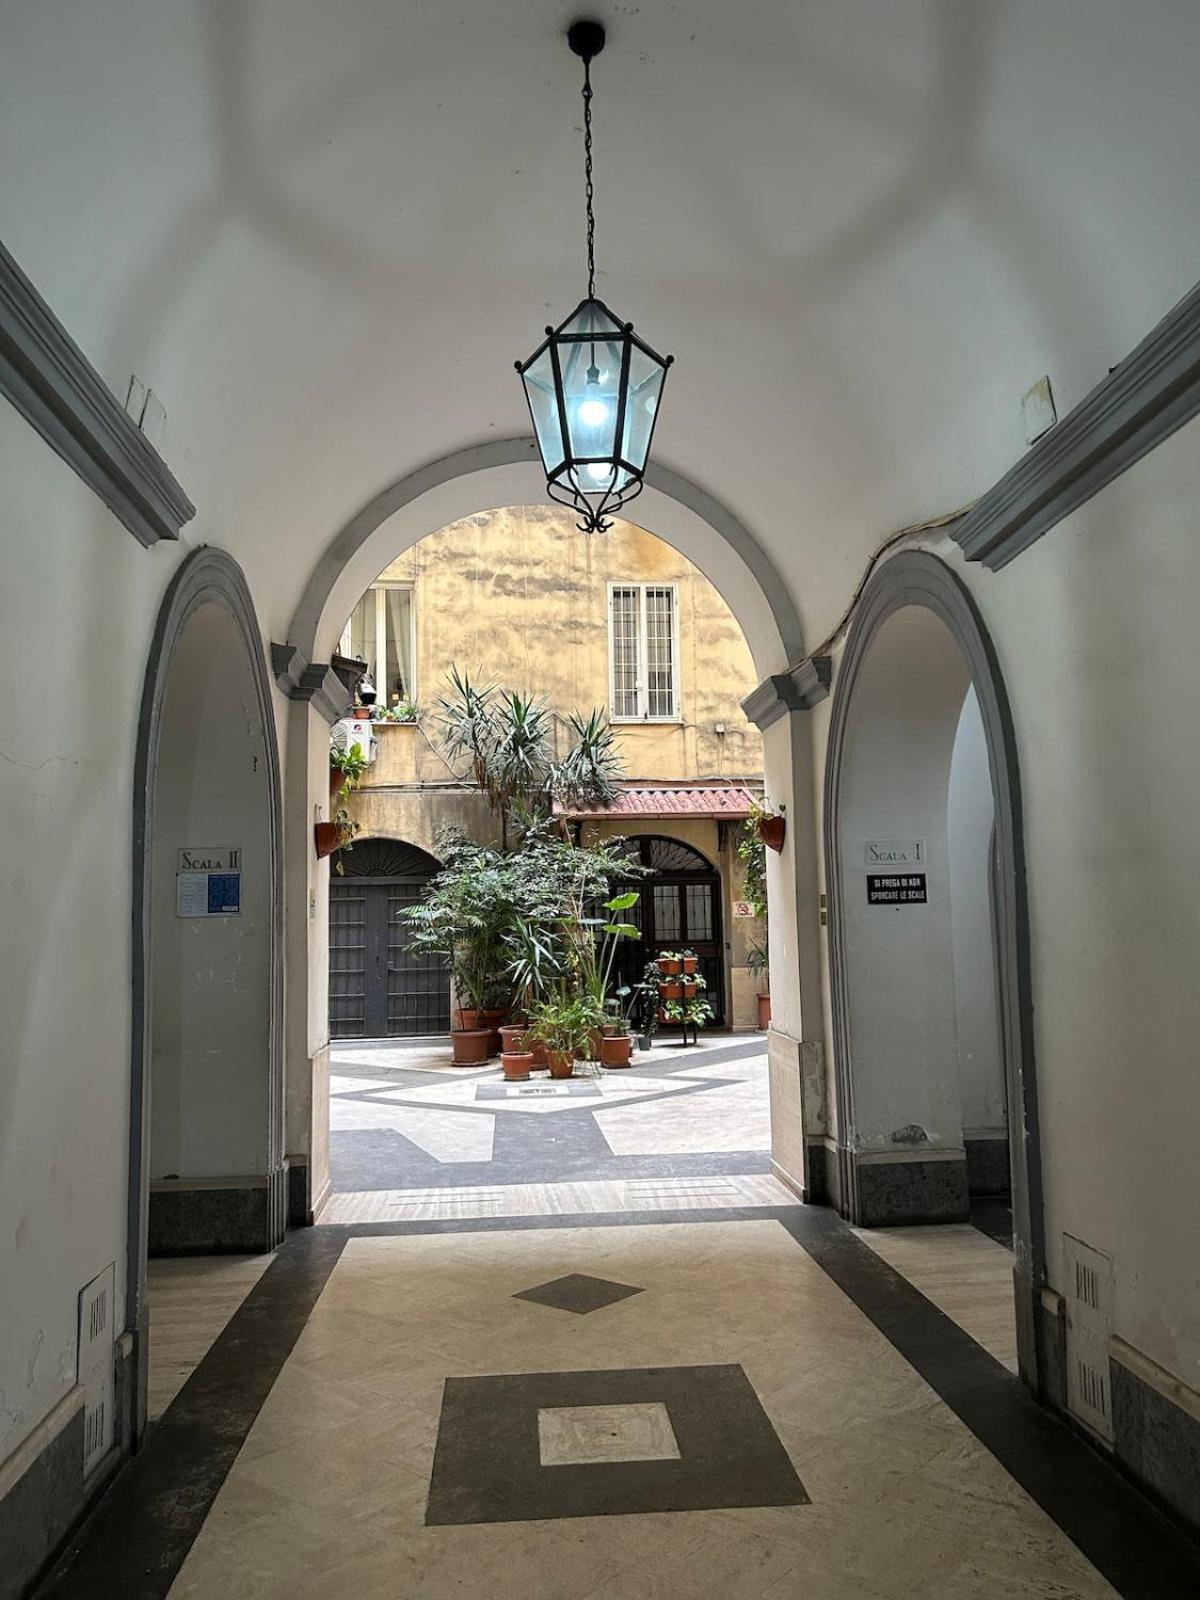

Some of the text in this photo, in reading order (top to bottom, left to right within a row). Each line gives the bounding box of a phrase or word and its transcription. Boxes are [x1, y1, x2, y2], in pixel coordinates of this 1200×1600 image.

[229, 850, 238, 869] II
[874, 878, 921, 888] SI PREGA DI NON
[900, 890, 907, 900] LE
[907, 890, 925, 899] SCALE
